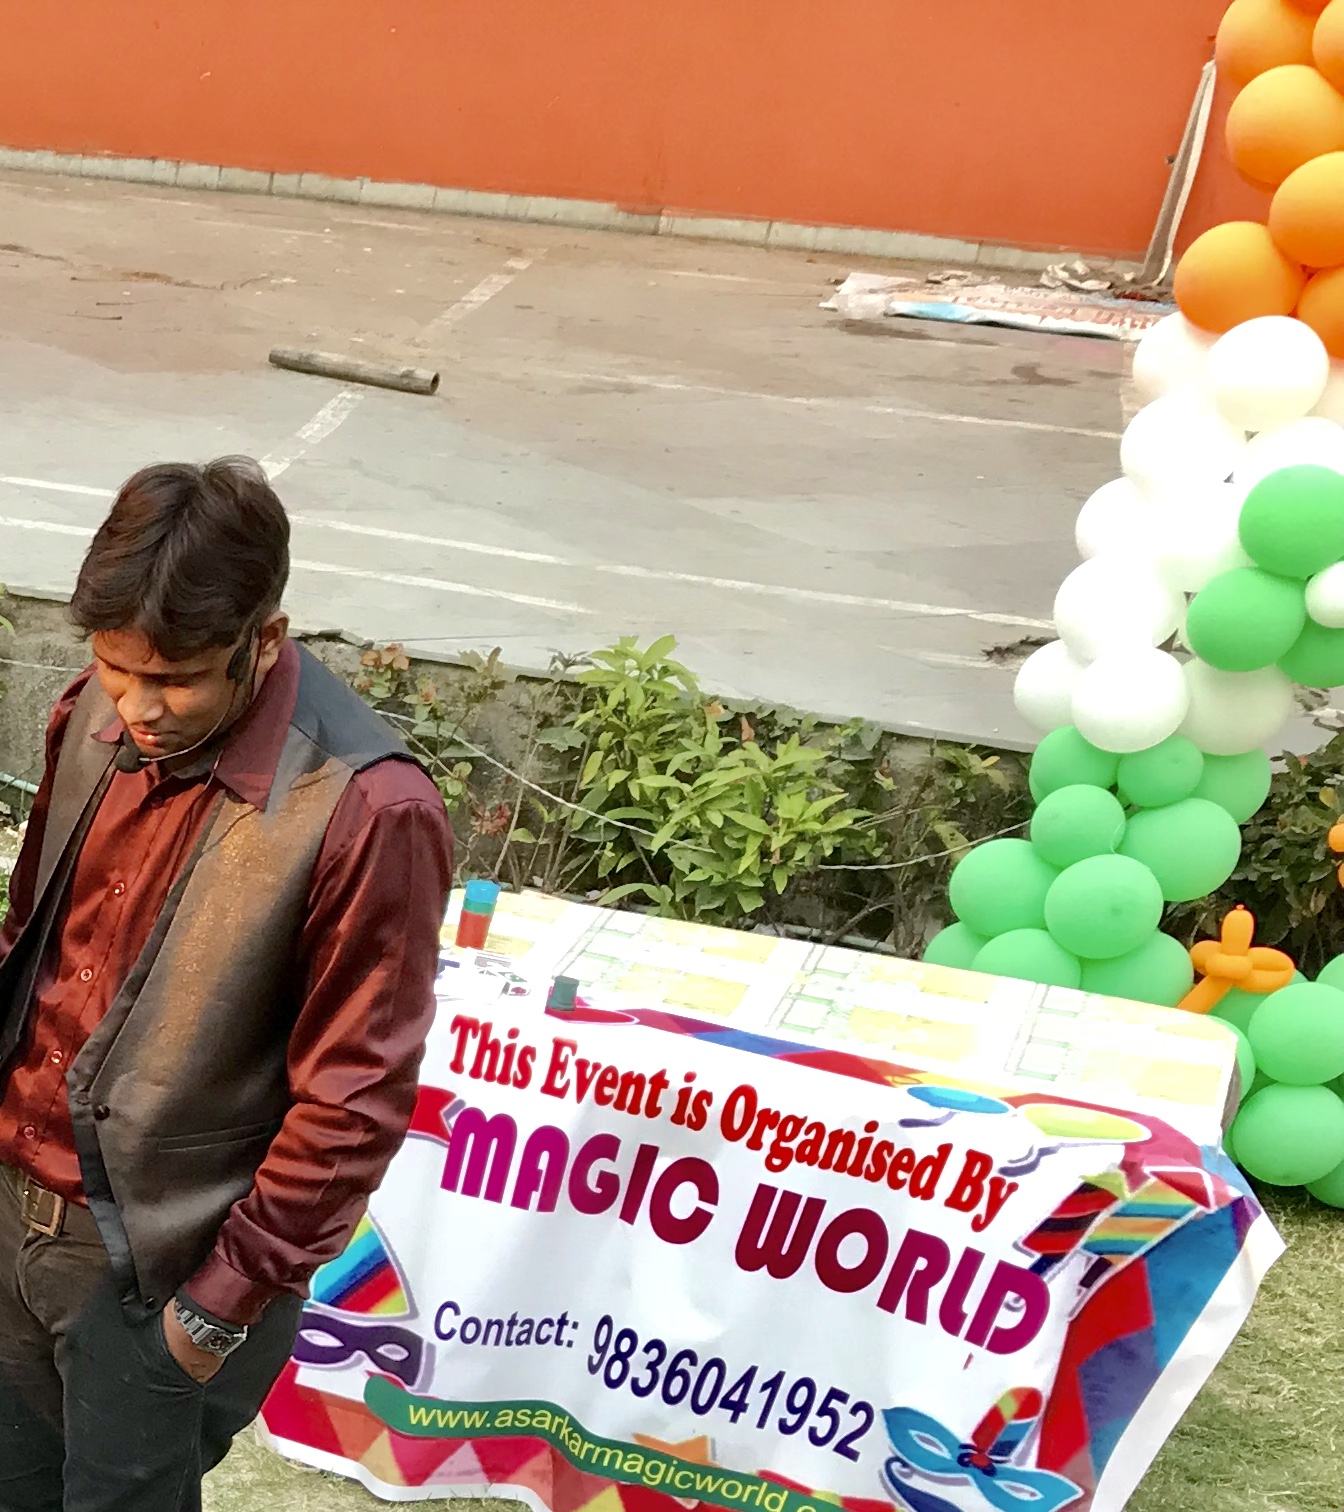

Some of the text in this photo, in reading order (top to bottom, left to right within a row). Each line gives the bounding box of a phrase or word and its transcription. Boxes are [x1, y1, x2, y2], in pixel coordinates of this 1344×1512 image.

[440, 1107, 1051, 1355] MAGIC WORLD
[449, 1014, 1019, 1232] This Event is Organised By
[434, 1301, 875, 1463] Contact: 9836041952
